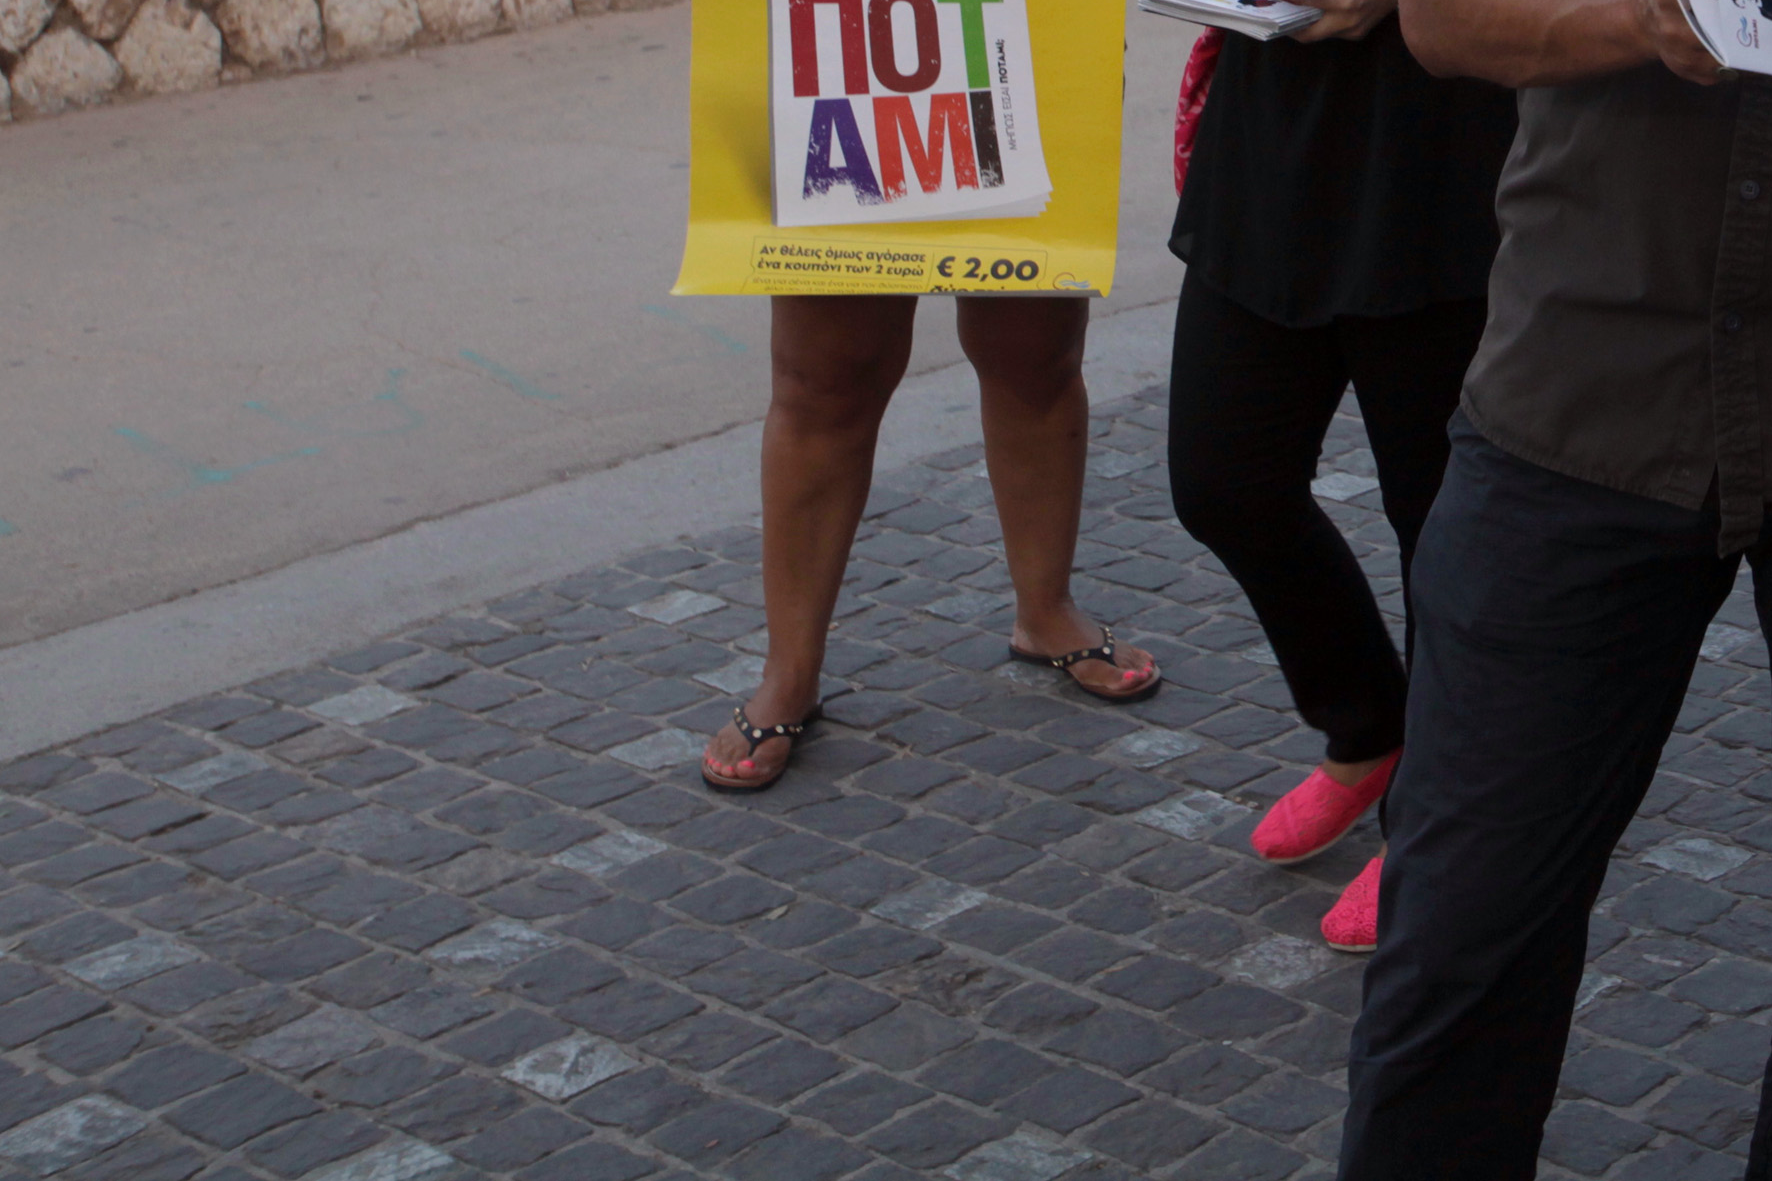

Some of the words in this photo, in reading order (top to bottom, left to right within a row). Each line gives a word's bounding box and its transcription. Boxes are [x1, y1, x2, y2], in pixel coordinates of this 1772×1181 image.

[803, 90, 1005, 206] ΑΜΙ
[759, 245, 777, 255] Αν
[780, 244, 822, 259] θέλεις
[825, 246, 863, 261] όμως
[866, 249, 926, 263] αγόρασε
[757, 258, 781, 270] ένα
[784, 261, 841, 273] κουπόνι
[845, 265, 872, 273] των
[875, 264, 883, 274] 2
[886, 265, 924, 278] ευρώ
[936, 255, 956, 277] €
[963, 256, 1040, 282] 2,00
